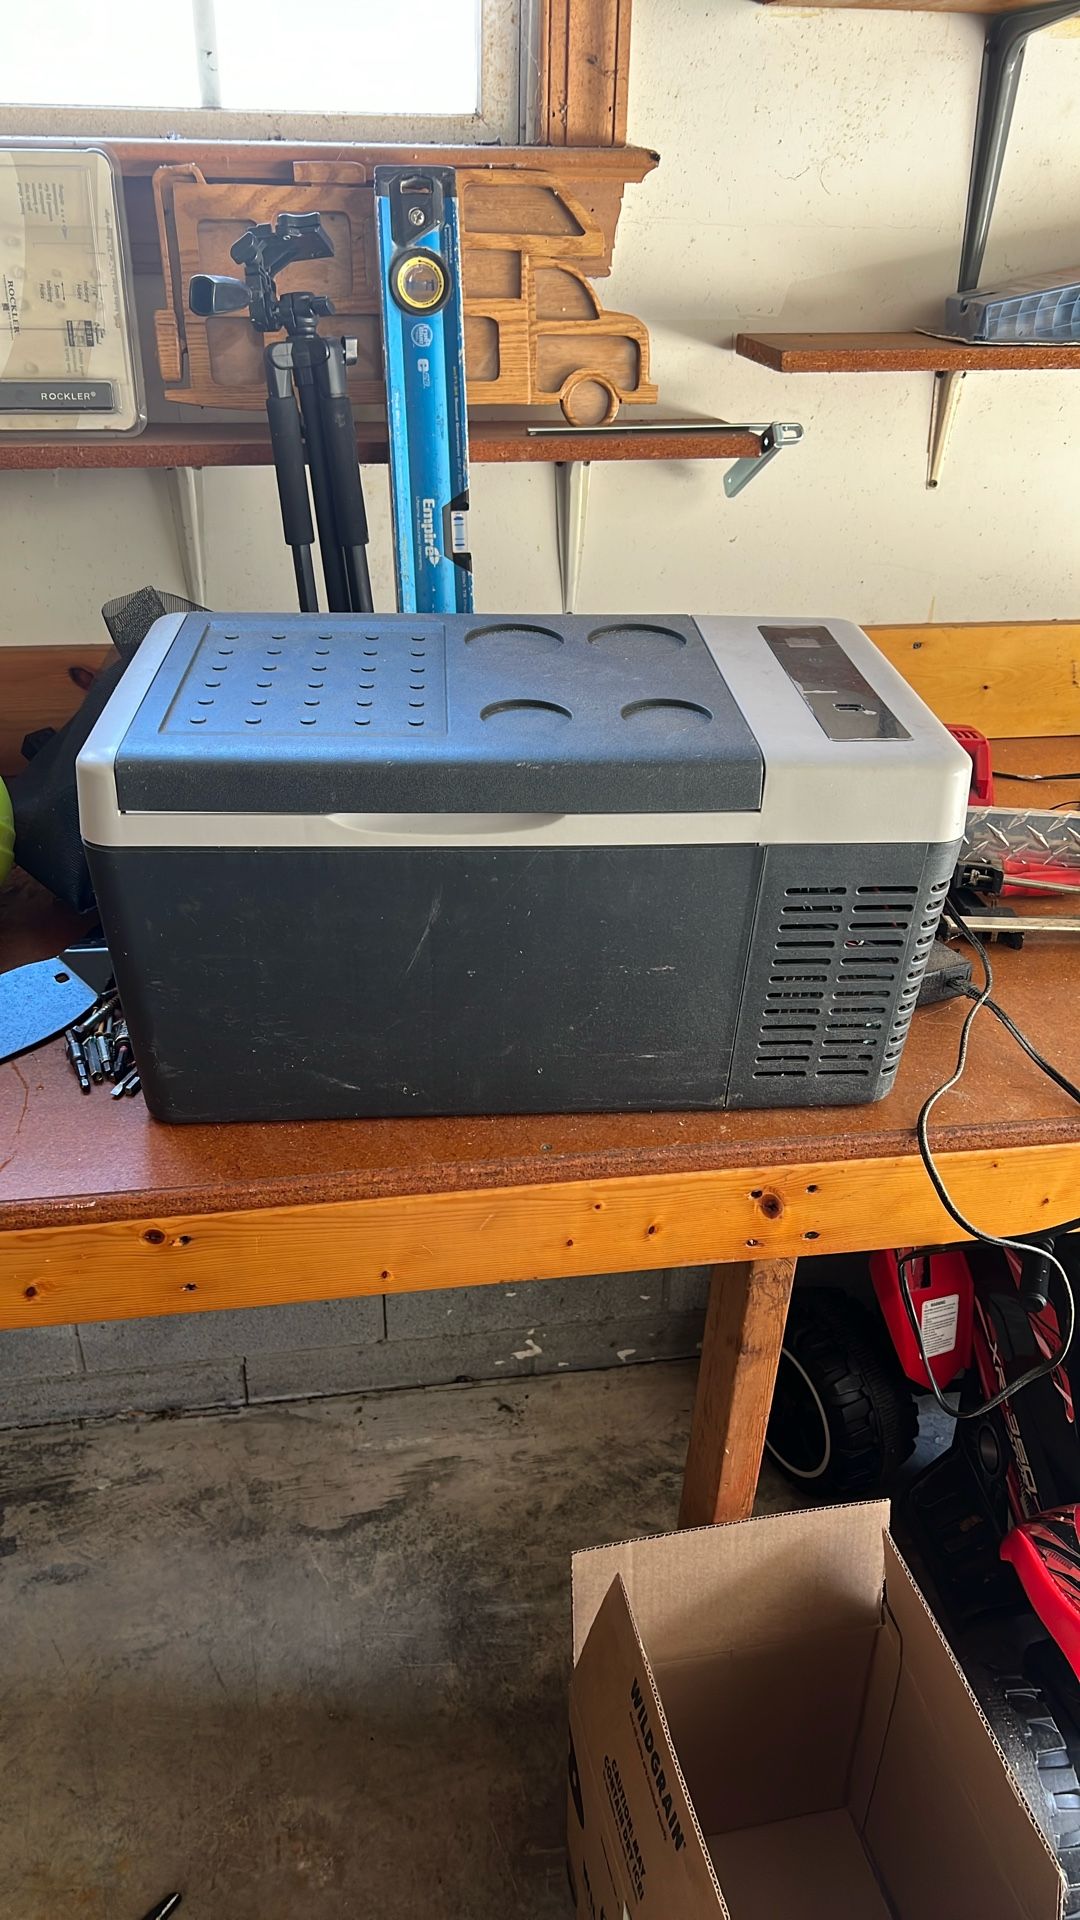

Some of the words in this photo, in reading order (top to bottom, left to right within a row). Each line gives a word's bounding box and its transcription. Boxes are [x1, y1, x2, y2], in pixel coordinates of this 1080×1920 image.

[8, 280, 20, 333] ROCKLER
[421, 498, 436, 557] Empire
[604, 1754, 626, 1828] CONTAIN
[622, 1828, 636, 1861] DRY
[632, 1838, 647, 1878] MAY
